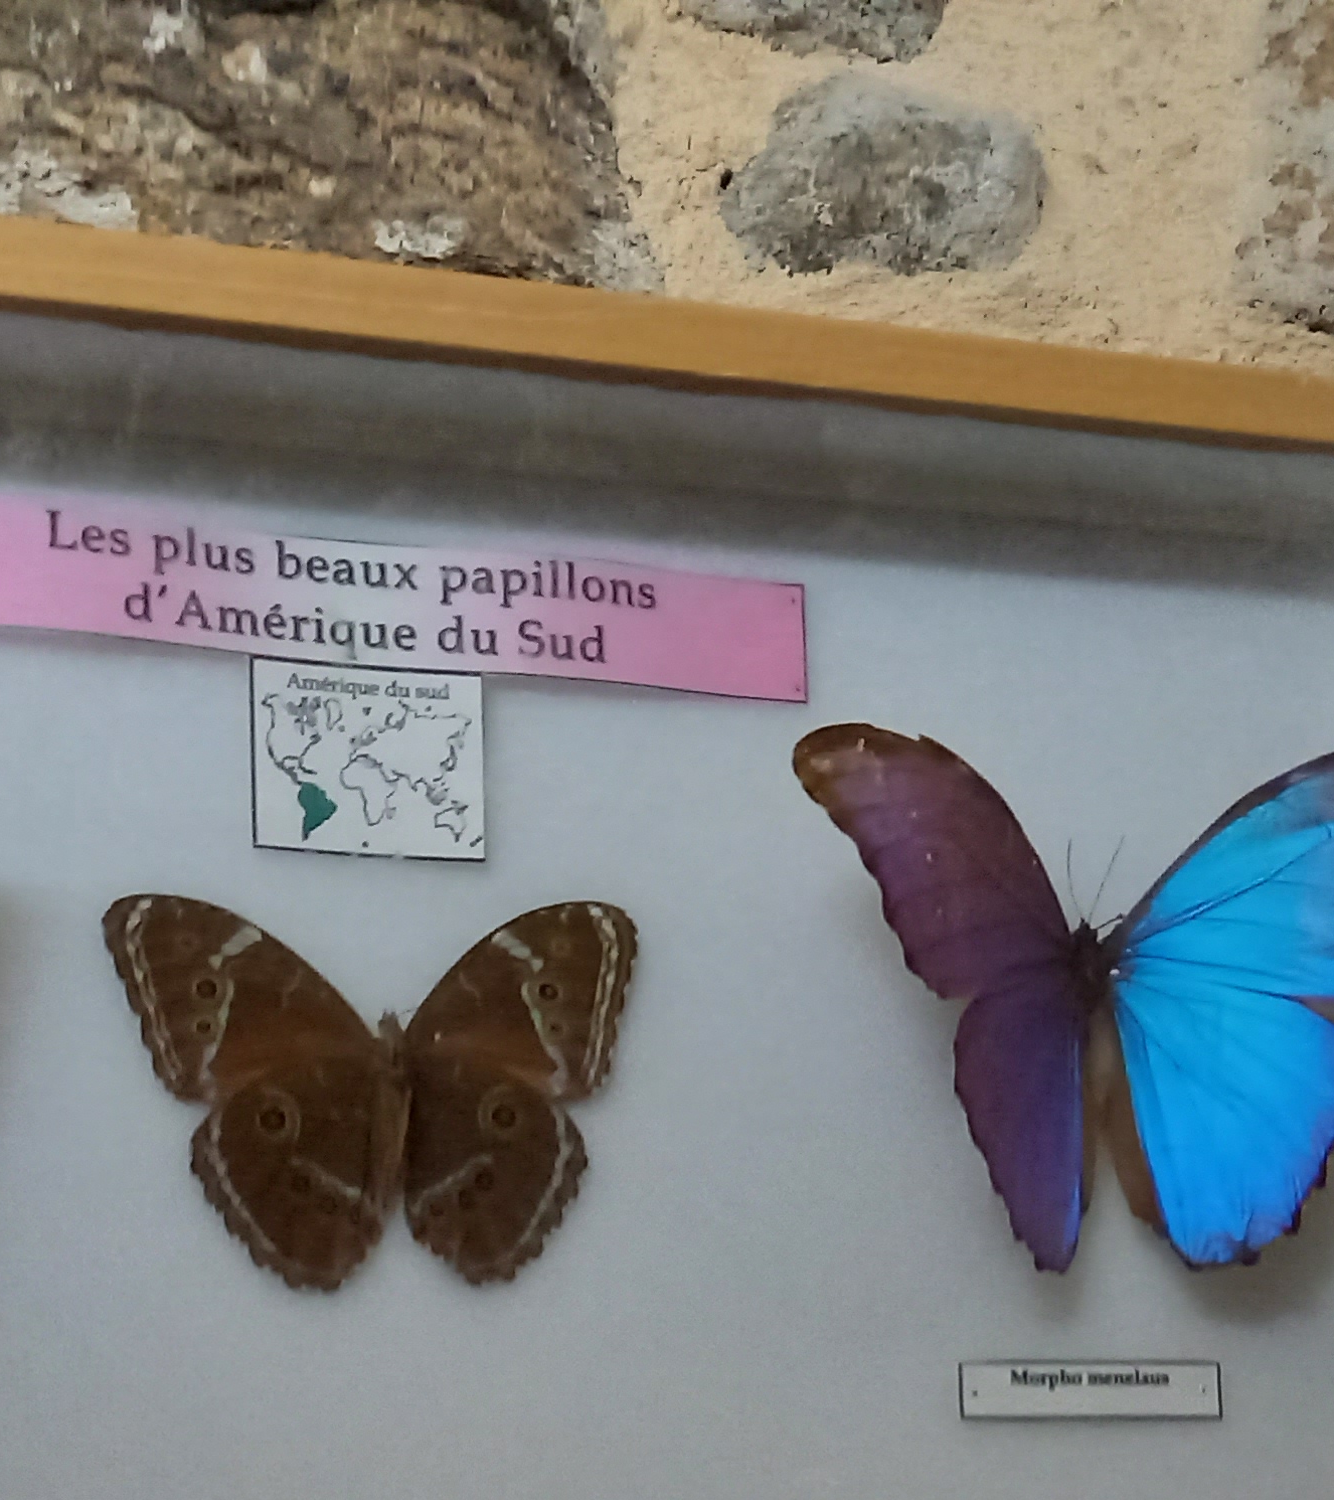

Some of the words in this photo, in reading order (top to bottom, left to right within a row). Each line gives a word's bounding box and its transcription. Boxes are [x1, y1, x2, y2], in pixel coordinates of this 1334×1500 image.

[46, 508, 131, 557] Les
[152, 526, 256, 575] plus
[275, 539, 418, 592] beaux
[439, 559, 657, 610] papillons
[437, 615, 499, 658] du
[517, 618, 607, 665] Sud
[287, 672, 380, 700] Amérique
[384, 679, 410, 698] du
[415, 683, 450, 700] sud
